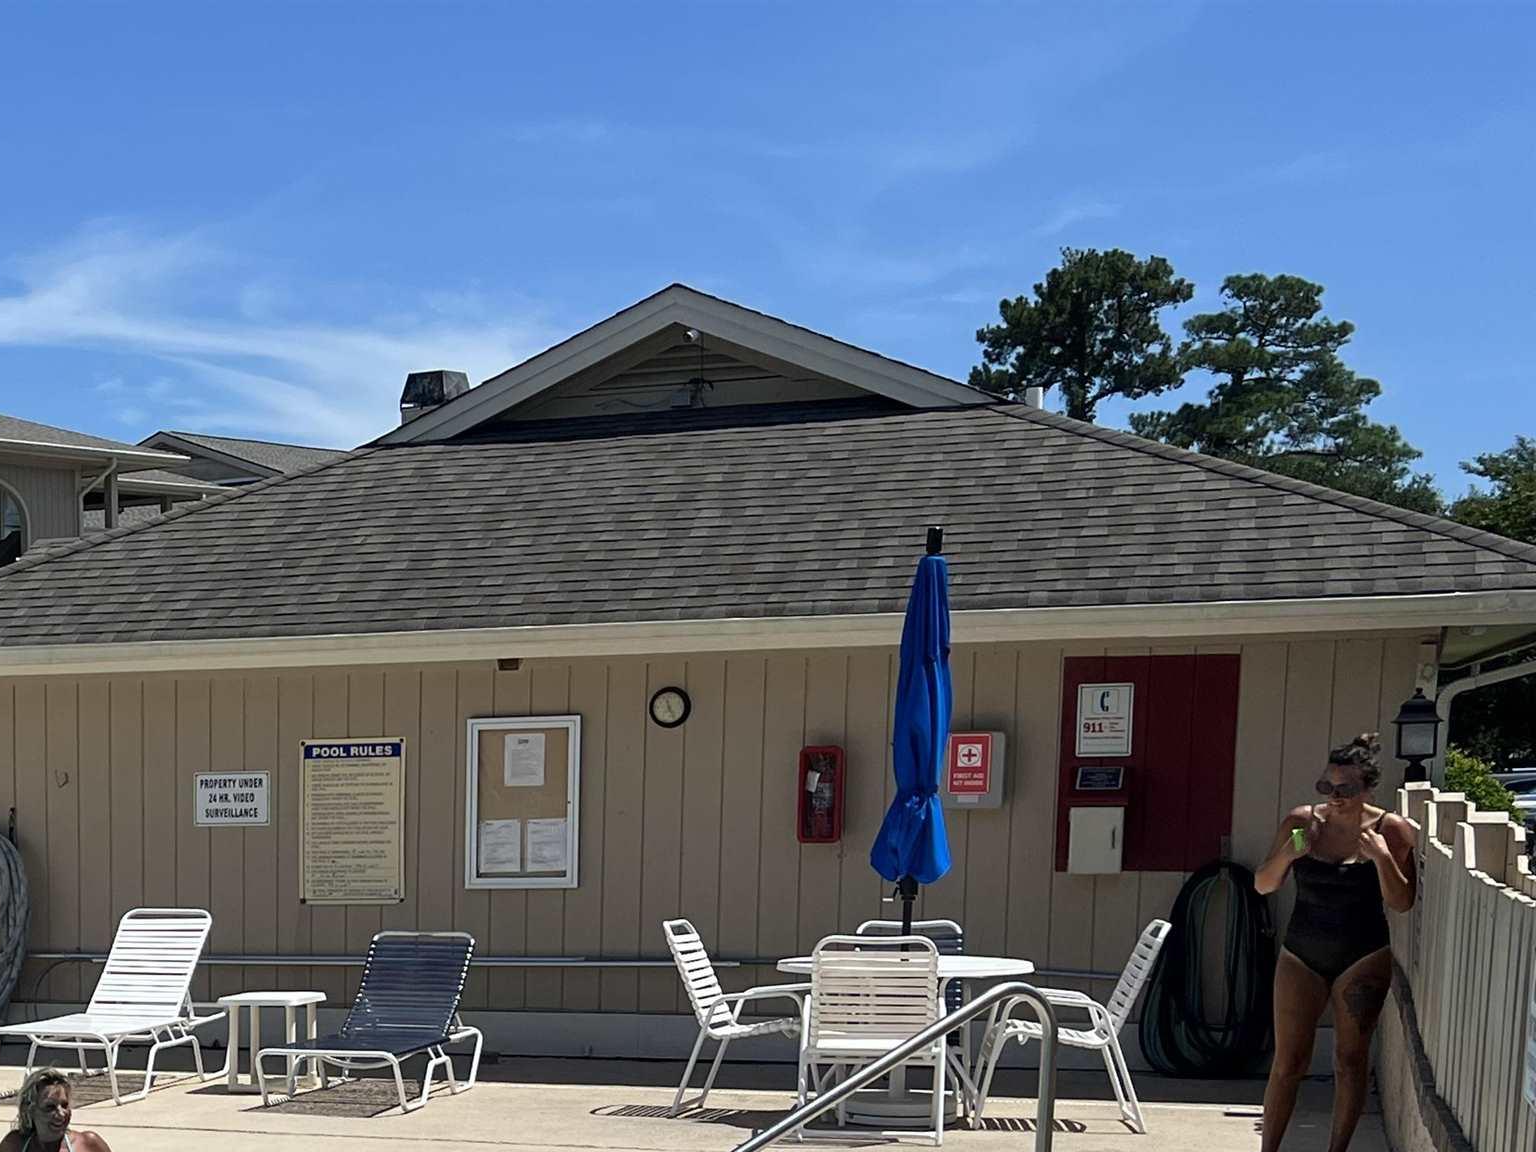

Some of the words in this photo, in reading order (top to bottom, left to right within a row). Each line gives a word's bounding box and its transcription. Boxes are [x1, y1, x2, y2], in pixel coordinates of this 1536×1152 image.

[1082, 722, 1104, 733] 911
[311, 747, 347, 757] POOL
[350, 745, 393, 757] RULES
[199, 778, 237, 789] PROPERTY
[238, 777, 264, 789] UNDER
[208, 793, 217, 804] 24
[232, 792, 256, 804] VIDEO
[204, 807, 259, 819] SURVEILLANCE
